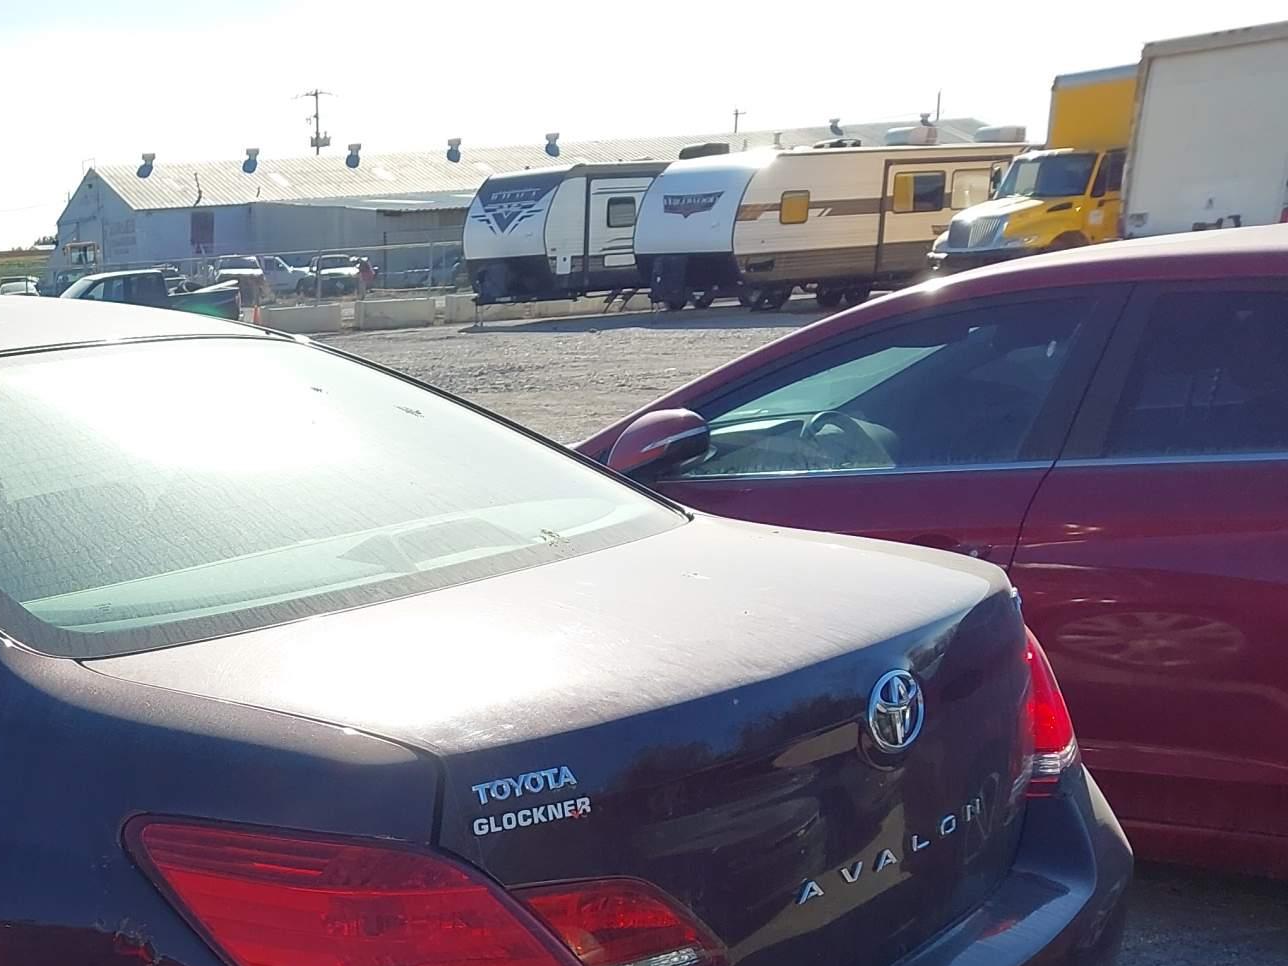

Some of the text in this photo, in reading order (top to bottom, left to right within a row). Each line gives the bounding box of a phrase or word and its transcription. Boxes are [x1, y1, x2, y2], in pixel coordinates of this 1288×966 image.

[471, 766, 578, 805] TOYOTA
[473, 797, 592, 835] GLOCKNER
[795, 797, 982, 905] AVALON
